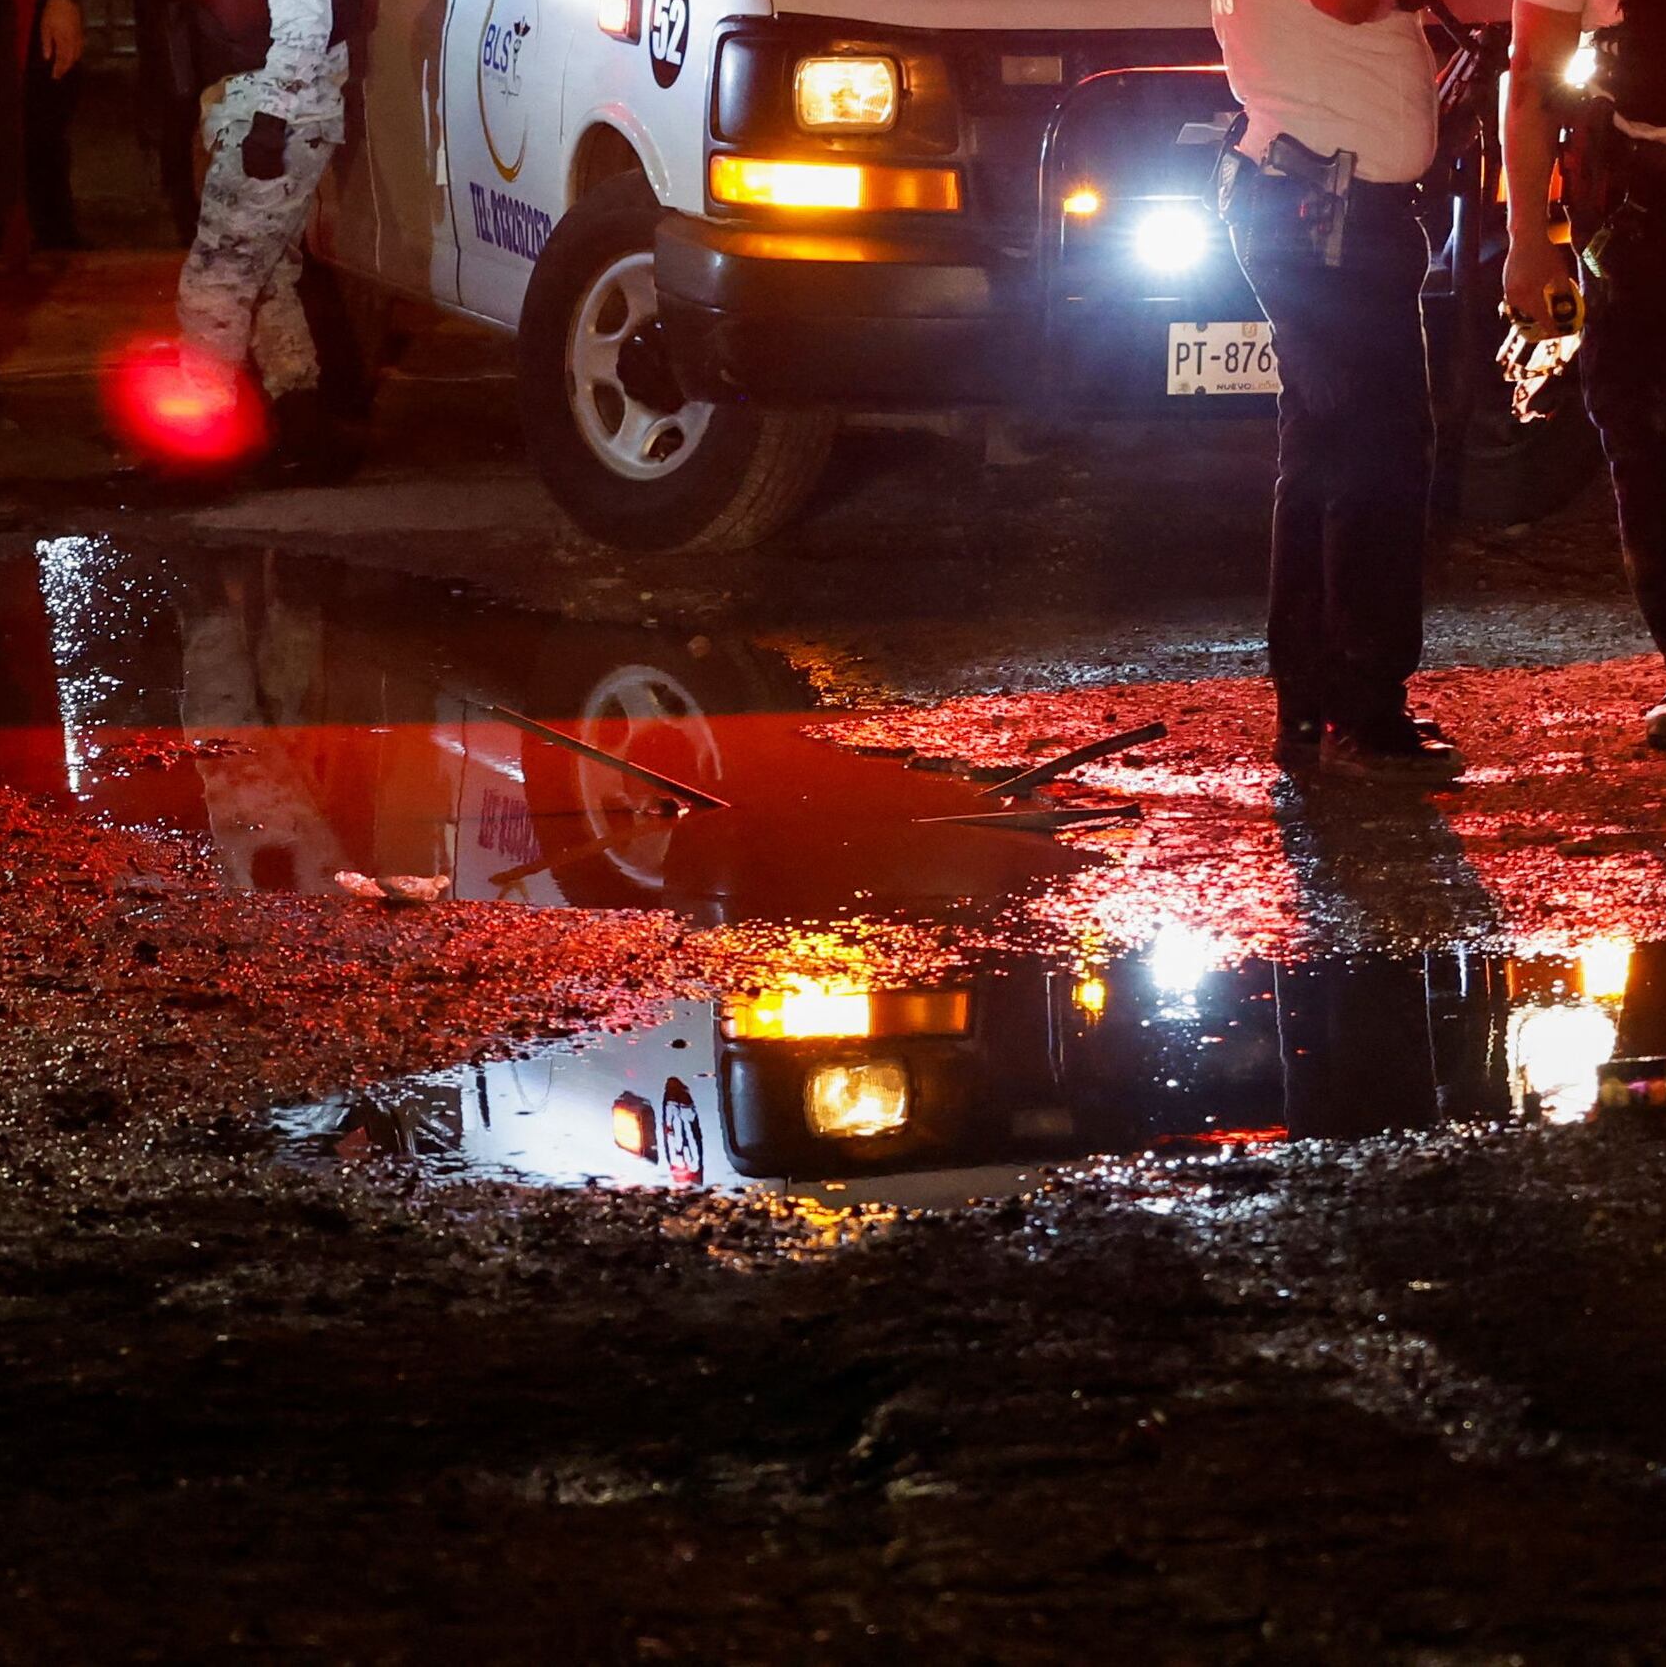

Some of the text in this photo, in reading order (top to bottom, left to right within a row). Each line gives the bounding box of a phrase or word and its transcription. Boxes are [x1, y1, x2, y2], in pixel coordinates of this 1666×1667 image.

[483, 23, 512, 74] BLS
[1175, 341, 1277, 376] PT-876
[1215, 382, 1251, 390] NUEVO
